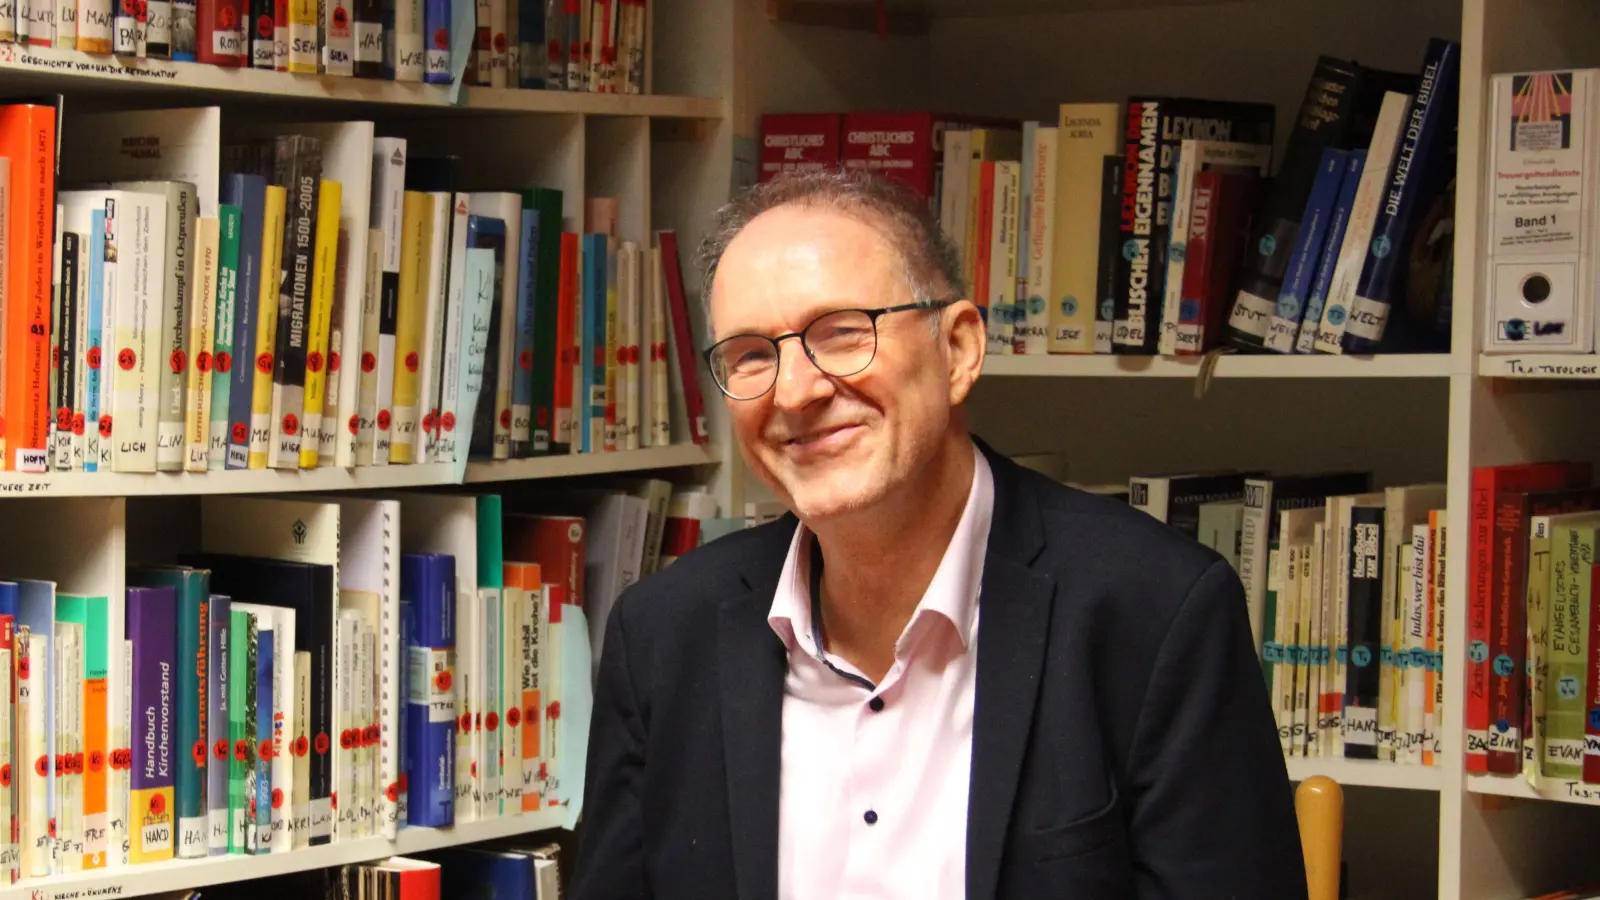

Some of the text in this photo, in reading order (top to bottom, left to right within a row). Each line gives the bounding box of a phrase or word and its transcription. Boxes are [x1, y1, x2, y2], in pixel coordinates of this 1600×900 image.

[21, 55, 73, 68] GESCHICHTE
[1386, 61, 1439, 216] DIE WELT DER BIBEL
[1134, 102, 1159, 235] EIGENNAMEN
[176, 190, 187, 258] Ostpreußen
[1514, 215, 1557, 228] Band 1
[204, 247, 212, 271] 1970
[290, 176, 314, 347] MIGRATIONEN 1500-2005
[1350, 309, 1384, 326] WELT
[120, 442, 147, 452] LICH
[1412, 557, 1423, 578] bist
[1413, 579, 1423, 602] wer
[530, 593, 539, 645] Kirche?
[1410, 603, 1424, 638] Judas,
[522, 625, 530, 690] Wie stabil
[158, 661, 169, 777] Kirchenvorstand
[145, 705, 156, 778] Handbuch
